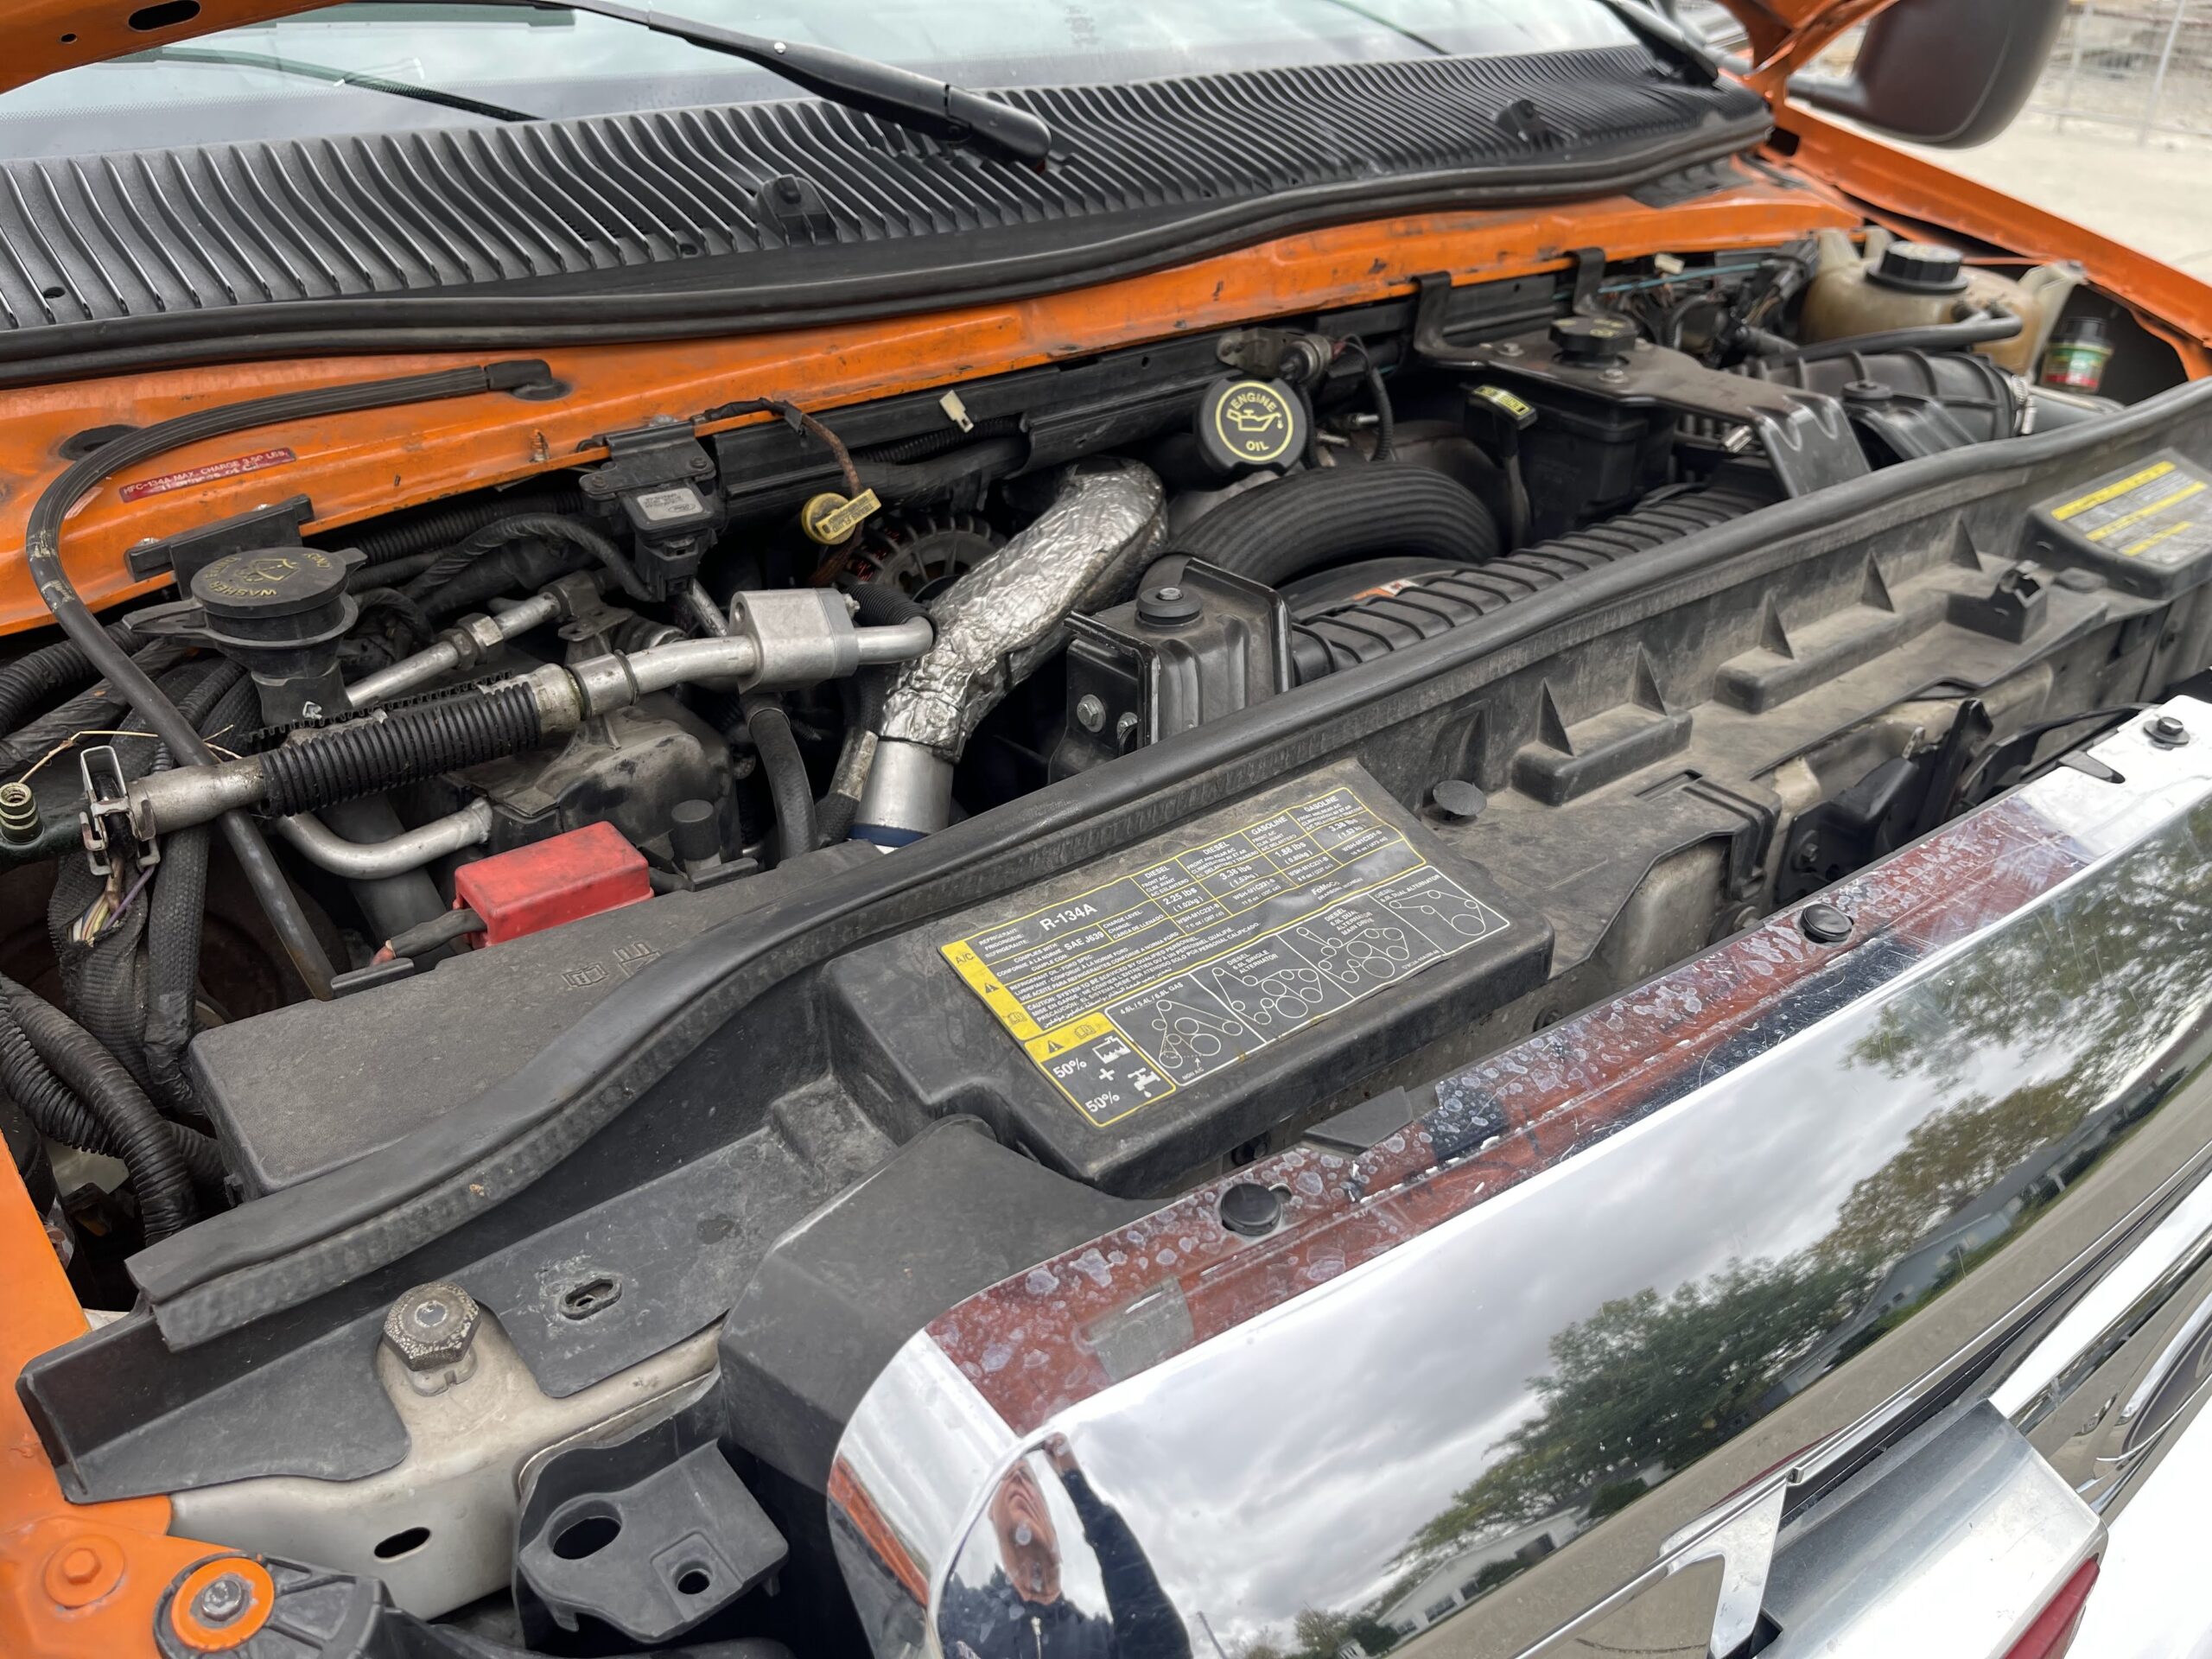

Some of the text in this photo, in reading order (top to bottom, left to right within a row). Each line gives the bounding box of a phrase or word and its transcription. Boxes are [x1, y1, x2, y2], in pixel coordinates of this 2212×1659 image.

[1230, 392, 1277, 412] ENGINE
[1246, 441, 1269, 452] OIL
[124, 477, 171, 494] HFC-134A
[200, 461, 239, 474] CHARGE
[210, 582, 276, 597] WASHER
[1302, 795, 1339, 812] GASOLINE
[1248, 816, 1289, 835] GASOLINE
[1201, 840, 1230, 855] DIESEL
[1290, 841, 1306, 850] lbs
[1142, 864, 1171, 878] DIESEL
[1185, 859, 1205, 869] FRONT
[1217, 863, 1253, 880] 3.38 lbs
[1141, 878, 1160, 887] FRONT
[1391, 888, 1408, 898] DUAL
[1404, 874, 1441, 892] ALTERNATOR
[1161, 887, 1198, 905] 2.25 lbs
[1038, 901, 1097, 931] R-134A
[1102, 917, 1126, 928] CHARGE
[1321, 906, 1348, 921] DIESEL
[1334, 911, 1373, 931] ALTERNATOR
[1340, 909, 1359, 919] DUAL
[1111, 928, 1133, 938] CARGA
[1137, 913, 1165, 927] LLENADO
[1339, 917, 1375, 935] MAIN DRIVE
[1063, 930, 1106, 950] SAE J639
[952, 951, 976, 964] A/C
[1012, 948, 1043, 963] COMPLIES
[1030, 958, 1055, 971] CUMPLE
[1225, 951, 1251, 965] DIESEL
[1231, 949, 1270, 969] 6.0L SINGLE
[1236, 952, 1279, 974] ALTERNATOR
[995, 961, 1029, 978] CONFORME
[1008, 971, 1049, 991] REFRIGERANT
[1060, 961, 1077, 970] FORD
[1031, 985, 1052, 996] ACEITE
[1051, 979, 1068, 988] PARA
[1066, 961, 1111, 982] REFRIGERANTES
[1109, 949, 1141, 964] CONFORME
[1144, 938, 1164, 950] NORMA
[1049, 966, 1081, 982] CONFORME
[1093, 953, 1114, 963] NORME
[1087, 984, 1115, 999] SISTEMA
[1113, 977, 1132, 988] DEBE
[1142, 960, 1172, 975] ATENDIDO
[1169, 953, 1187, 963] SOLO
[1185, 948, 1199, 957] POR
[1197, 936, 1229, 952] PERSONAL
[1027, 995, 1056, 1010] CAUTION:
[1055, 985, 1082, 999] SYSTEM
[1097, 965, 1128, 981] SERVICED
[1135, 949, 1166, 964] QUALIFIED
[1031, 1006, 1049, 1016] MISE
[1056, 993, 1079, 1006] GARDE
[1090, 976, 1118, 991] CONFIER
[1173, 937, 1209, 955] PERSONNEL
[1167, 982, 1185, 992] GAS
[1051, 1056, 1088, 1079] 50%
[1084, 1089, 1122, 1113] 50%
